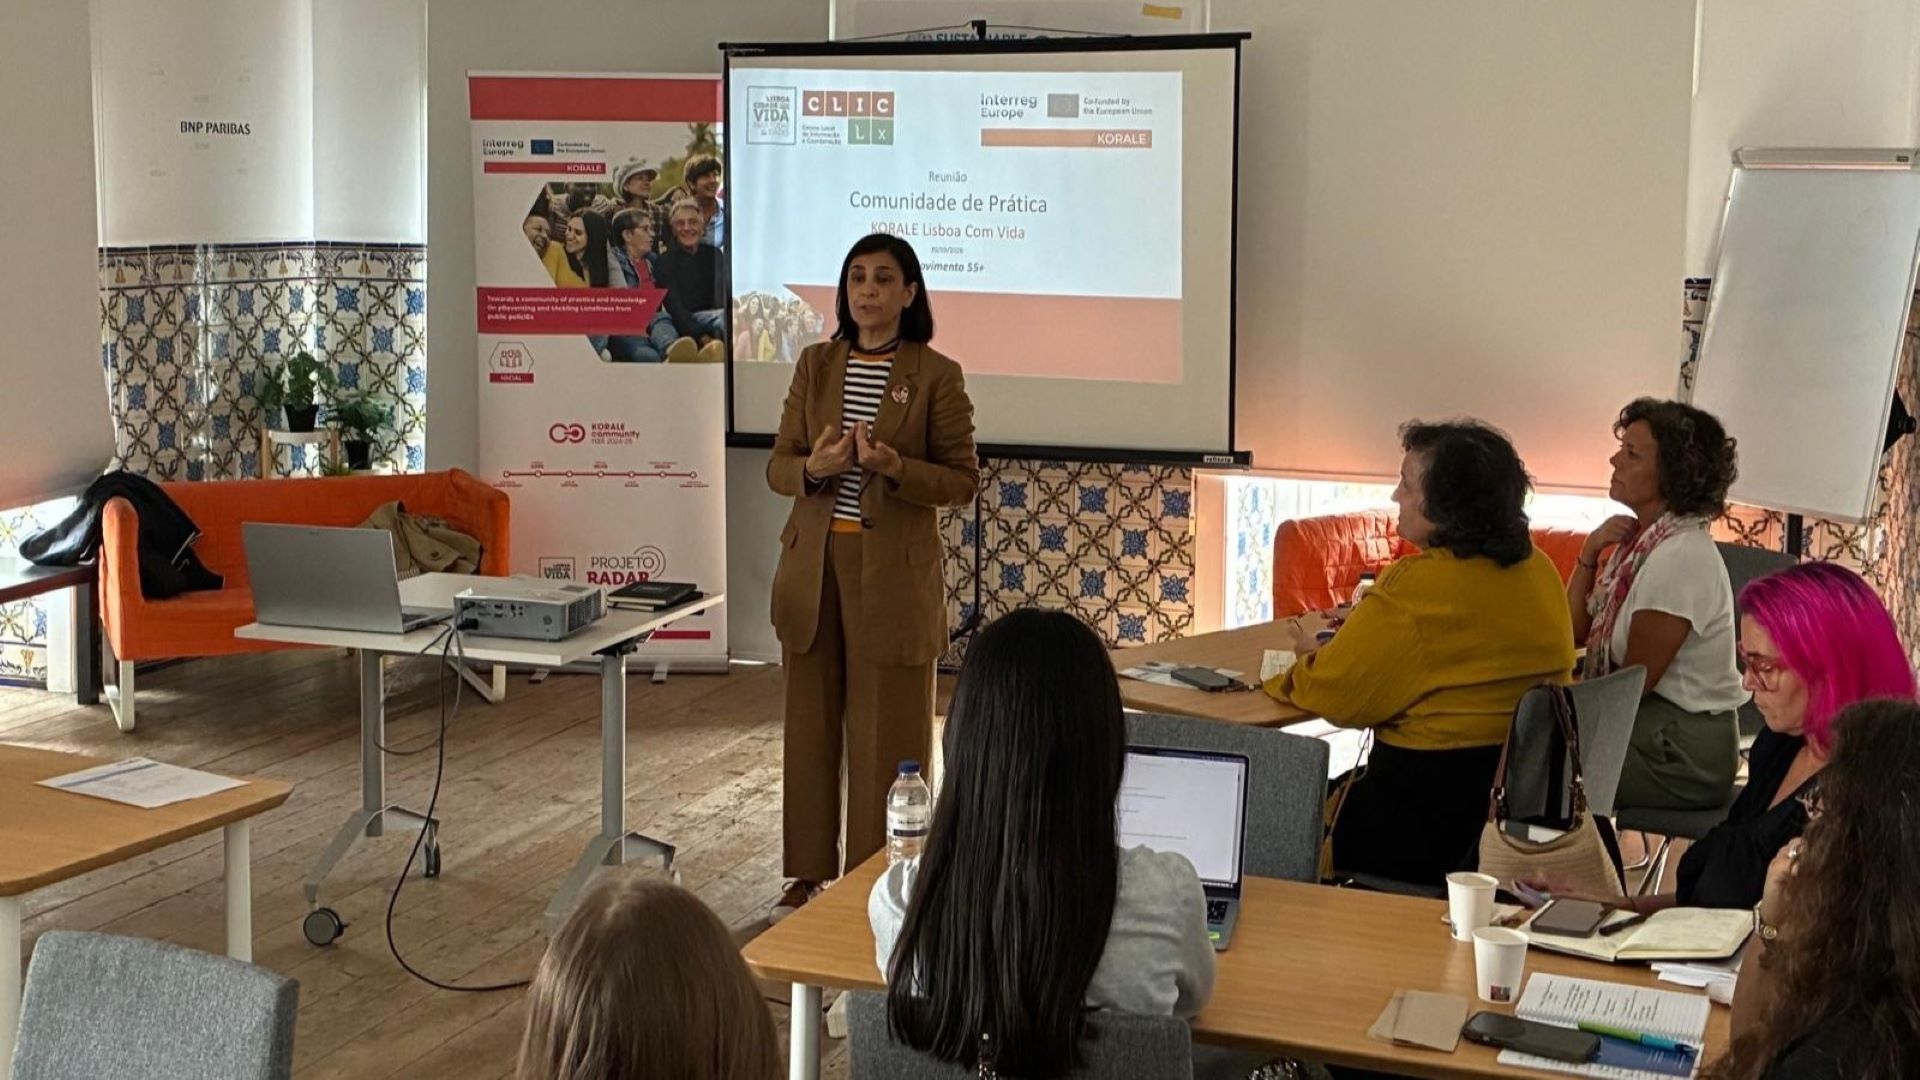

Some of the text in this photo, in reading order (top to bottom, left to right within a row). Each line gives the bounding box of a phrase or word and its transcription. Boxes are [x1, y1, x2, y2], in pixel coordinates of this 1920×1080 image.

[808, 97, 889, 113] CLIC
[981, 93, 1037, 108] Interreg
[753, 109, 790, 122] VIDA
[981, 108, 1024, 120] Europe
[180, 121, 251, 135] BNP PARIBAS
[482, 139, 523, 149] Interreg
[1097, 134, 1146, 144] KORALE
[566, 164, 602, 172] KORALE
[929, 171, 967, 182] Reunião
[850, 191, 1047, 213] Comunidade de Prática
[871, 222, 1025, 239] KORALE Lisboa Com Vida
[920, 261, 964, 272] ovimento
[591, 423, 625, 431] KORALE
[591, 430, 640, 440] community
[591, 556, 654, 569] PROJETO
[544, 566, 570, 579] VIDA
[587, 571, 649, 585] RADAR
